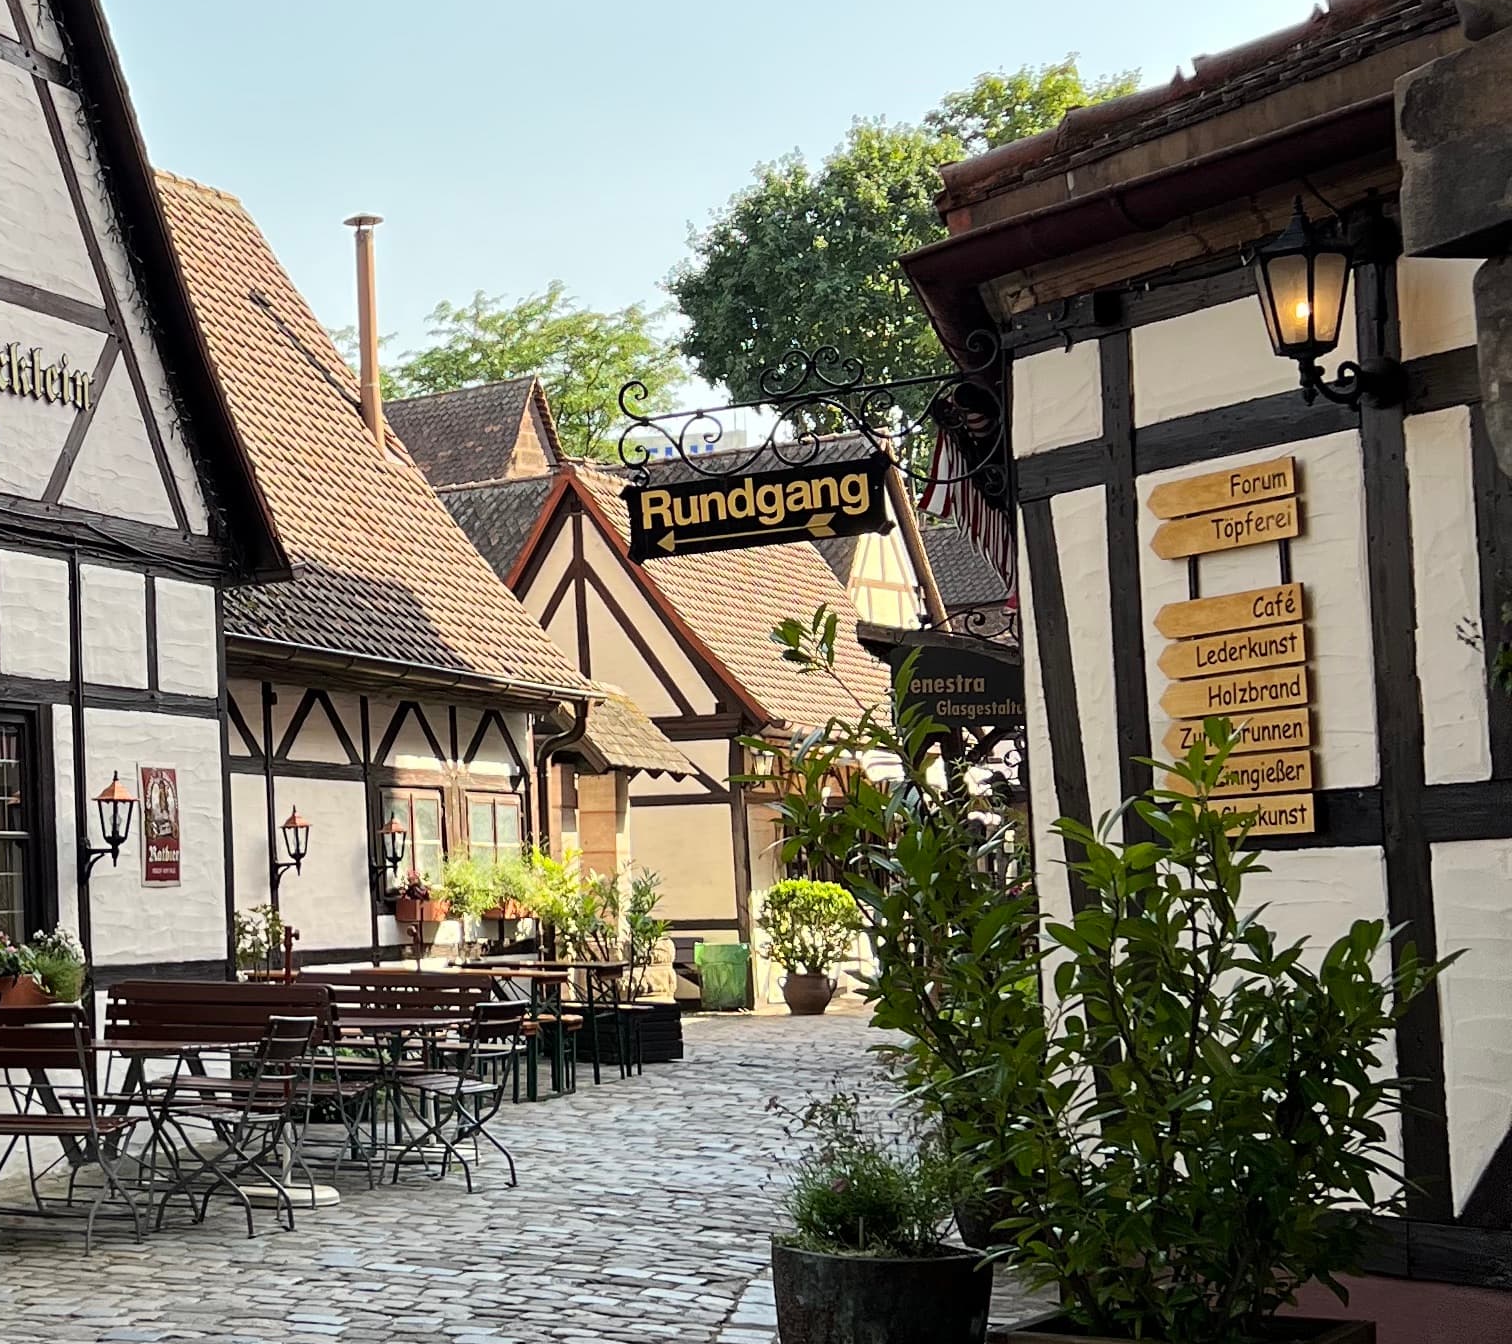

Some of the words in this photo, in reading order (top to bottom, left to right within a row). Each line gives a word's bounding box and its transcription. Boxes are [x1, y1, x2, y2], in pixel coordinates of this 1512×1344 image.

[640, 472, 870, 530] Rundgang
[1230, 471, 1288, 497] Forum
[1211, 505, 1292, 543] Töpferei
[1252, 589, 1296, 619] Café
[1196, 632, 1298, 668] Lederkunst
[906, 674, 985, 694] enestra
[1208, 674, 1301, 708] Holzbrand
